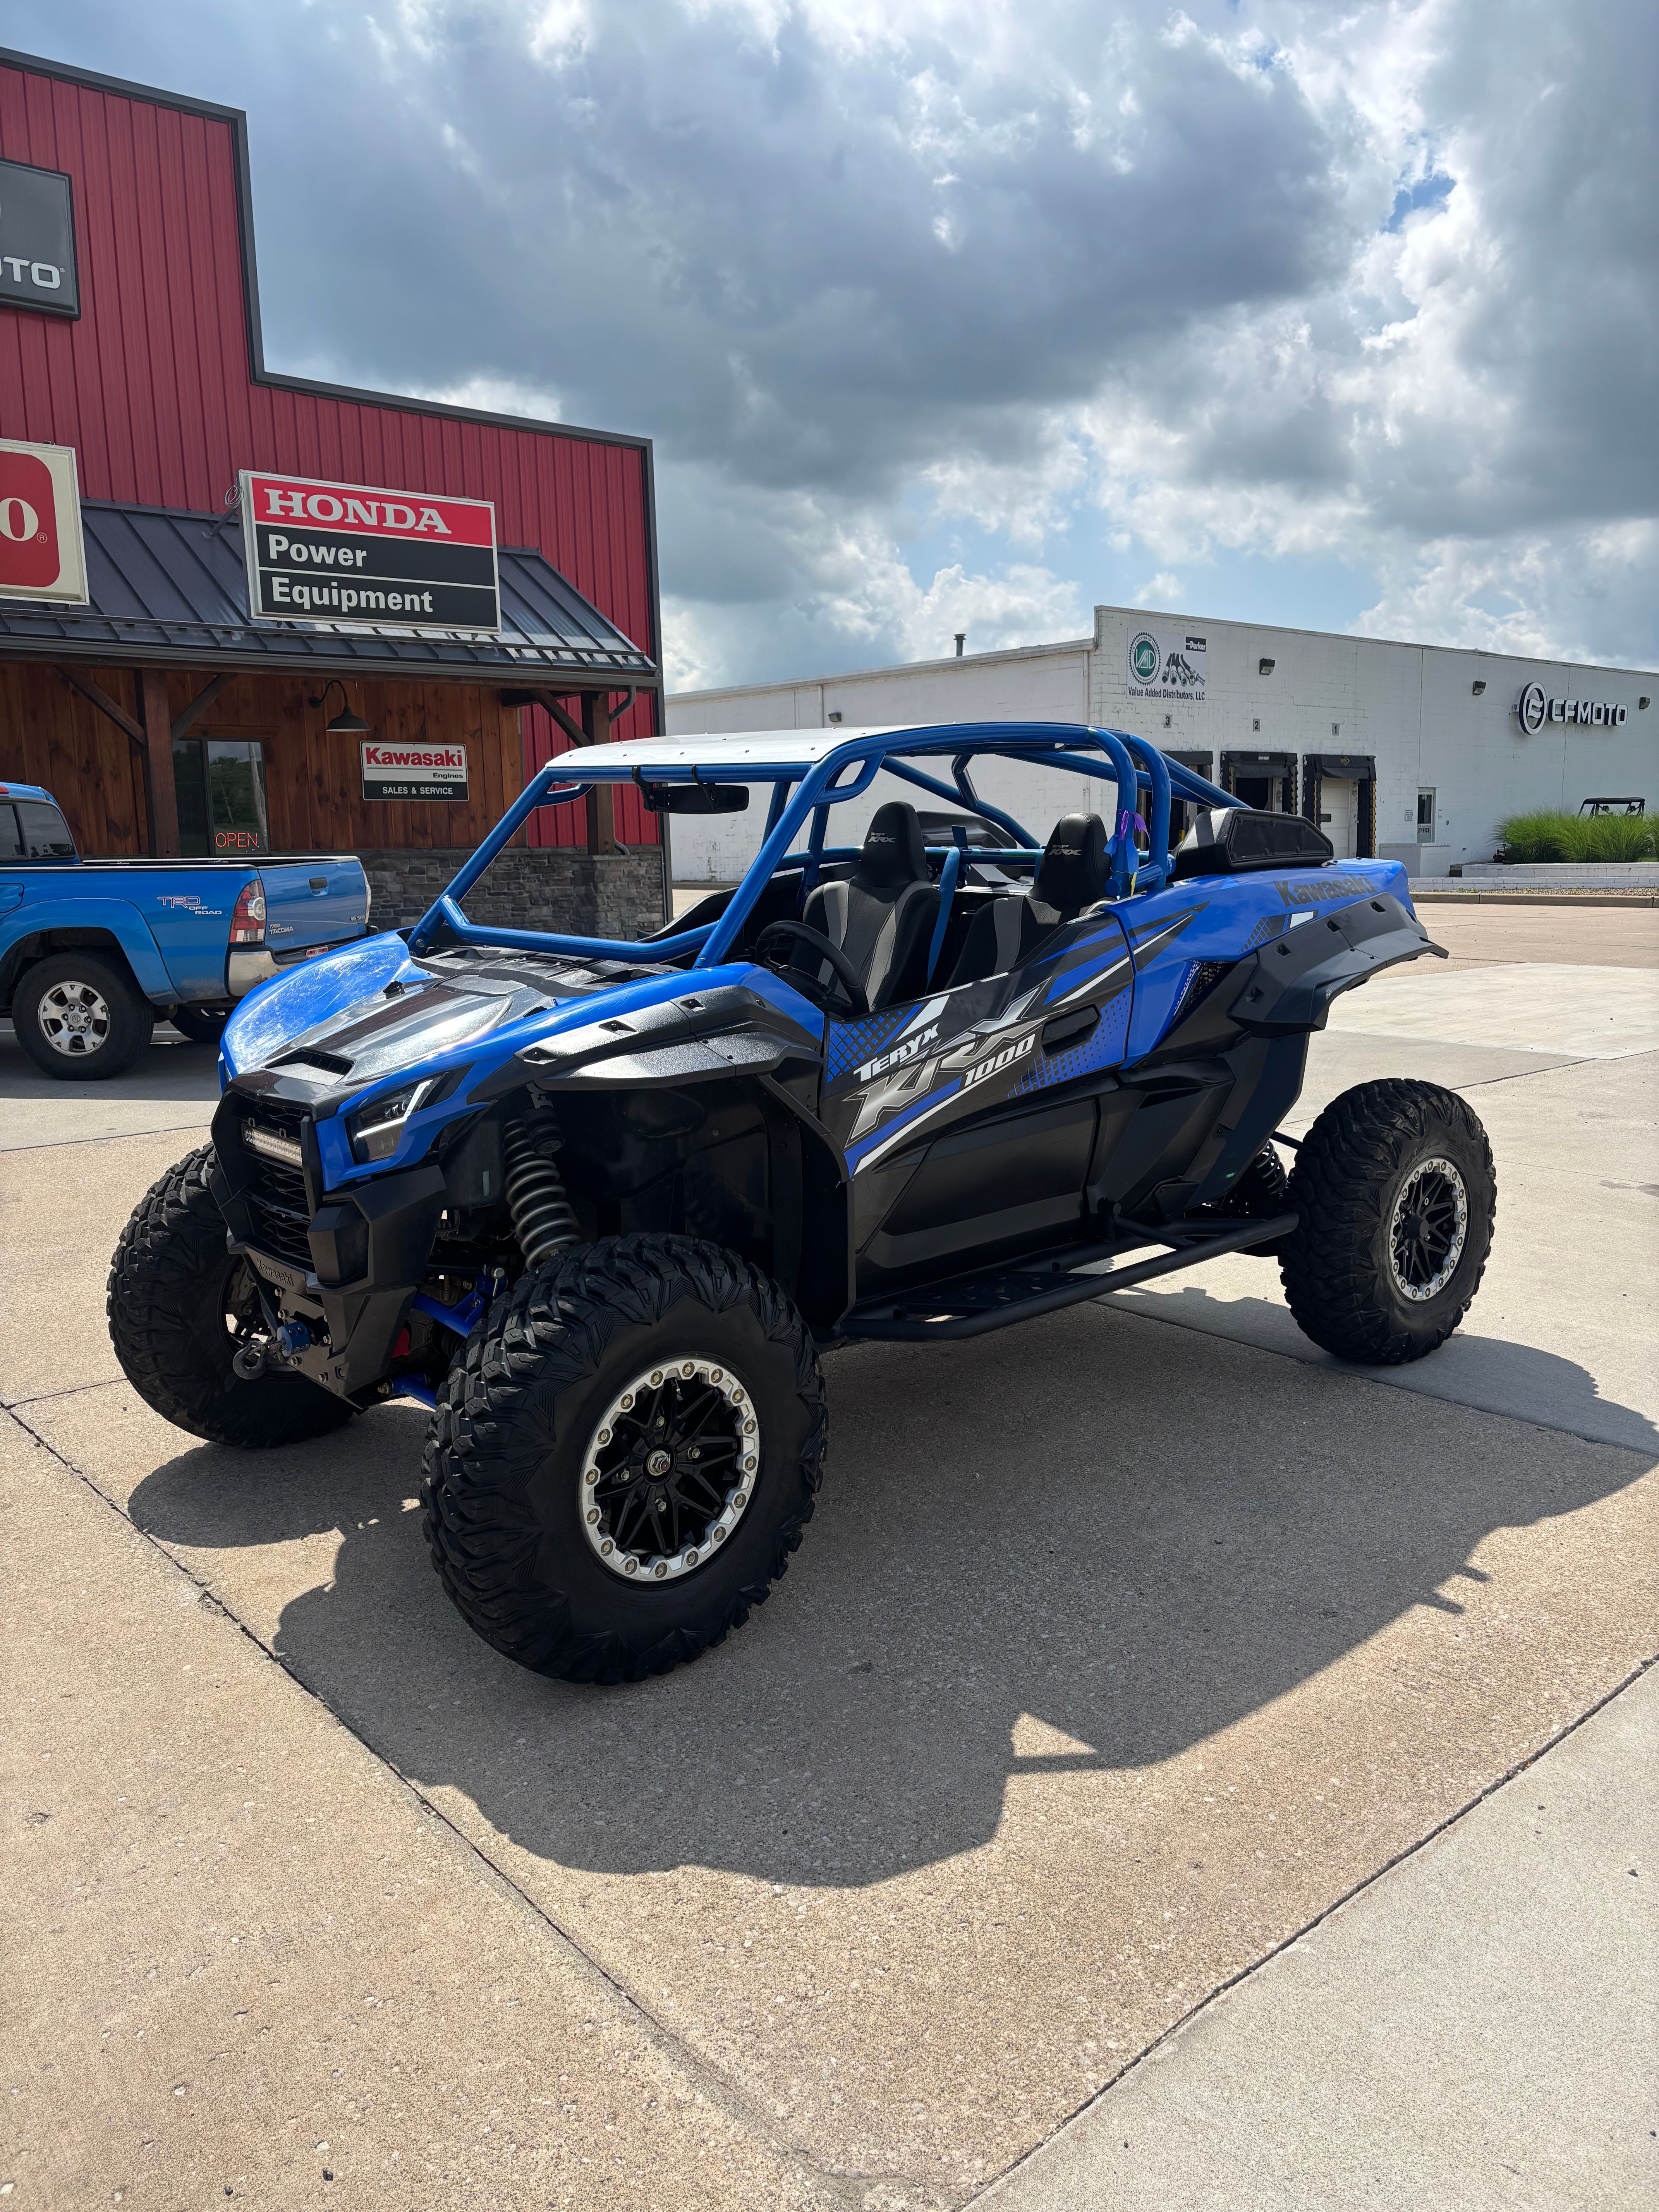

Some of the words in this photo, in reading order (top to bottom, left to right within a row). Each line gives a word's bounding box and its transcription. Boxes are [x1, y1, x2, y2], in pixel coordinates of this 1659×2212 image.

[264, 488, 452, 534] HONDA
[268, 534, 367, 567] Power
[272, 577, 433, 613] Equipment
[1189, 641, 1206, 650] Parker
[1128, 687, 1143, 696] Value
[1145, 688, 1161, 697] Added
[1163, 689, 1194, 700] Distributors,
[1196, 692, 1205, 700] LLC
[1165, 716, 1170, 726] 3
[1254, 720, 1259, 730] 2
[1549, 698, 1628, 726] CFMOTO
[1334, 725, 1337, 733] 1
[366, 747, 462, 766] Kawasaki
[215, 833, 258, 848] OPEN
[157, 896, 200, 908] TRD
[1274, 873, 1377, 907] Kawasaki
[841, 976, 1051, 1149] KRX
[853, 1023, 939, 1082] TERYX
[965, 1034, 1036, 1087] 1000
[256, 1258, 294, 1286] Kawasaki
